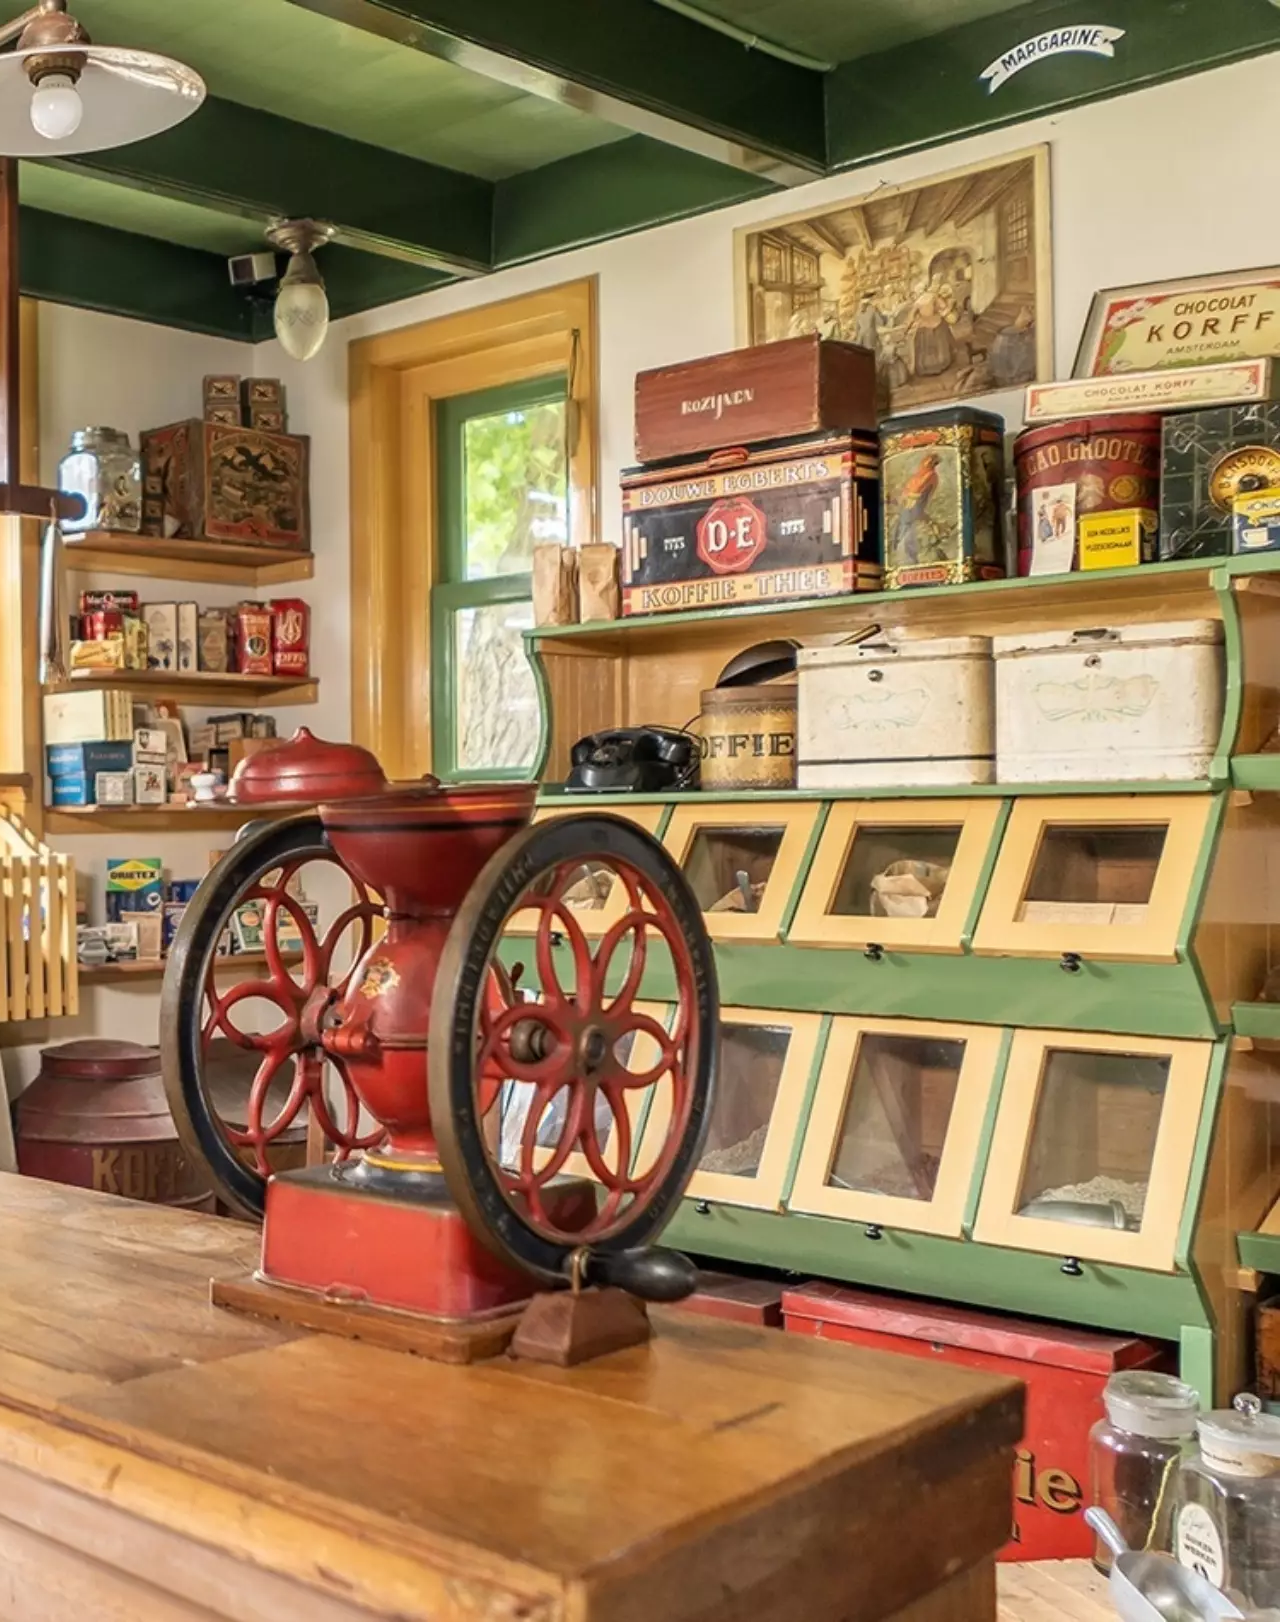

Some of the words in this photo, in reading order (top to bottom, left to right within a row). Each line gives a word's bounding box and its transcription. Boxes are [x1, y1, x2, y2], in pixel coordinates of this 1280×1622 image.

[1001, 29, 1103, 72] MARGARINE
[1174, 294, 1257, 317] CHOCOLAT
[1146, 310, 1274, 343] KORFF
[1166, 339, 1241, 355] AMSTERDAM
[1083, 383, 1148, 398] CHOCOLAT
[1154, 378, 1197, 391] KORFF
[640, 481, 717, 506] DOUWE
[722, 460, 829, 492] EGBERTS
[642, 578, 737, 609] KOFFIE
[755, 567, 831, 595] THEE
